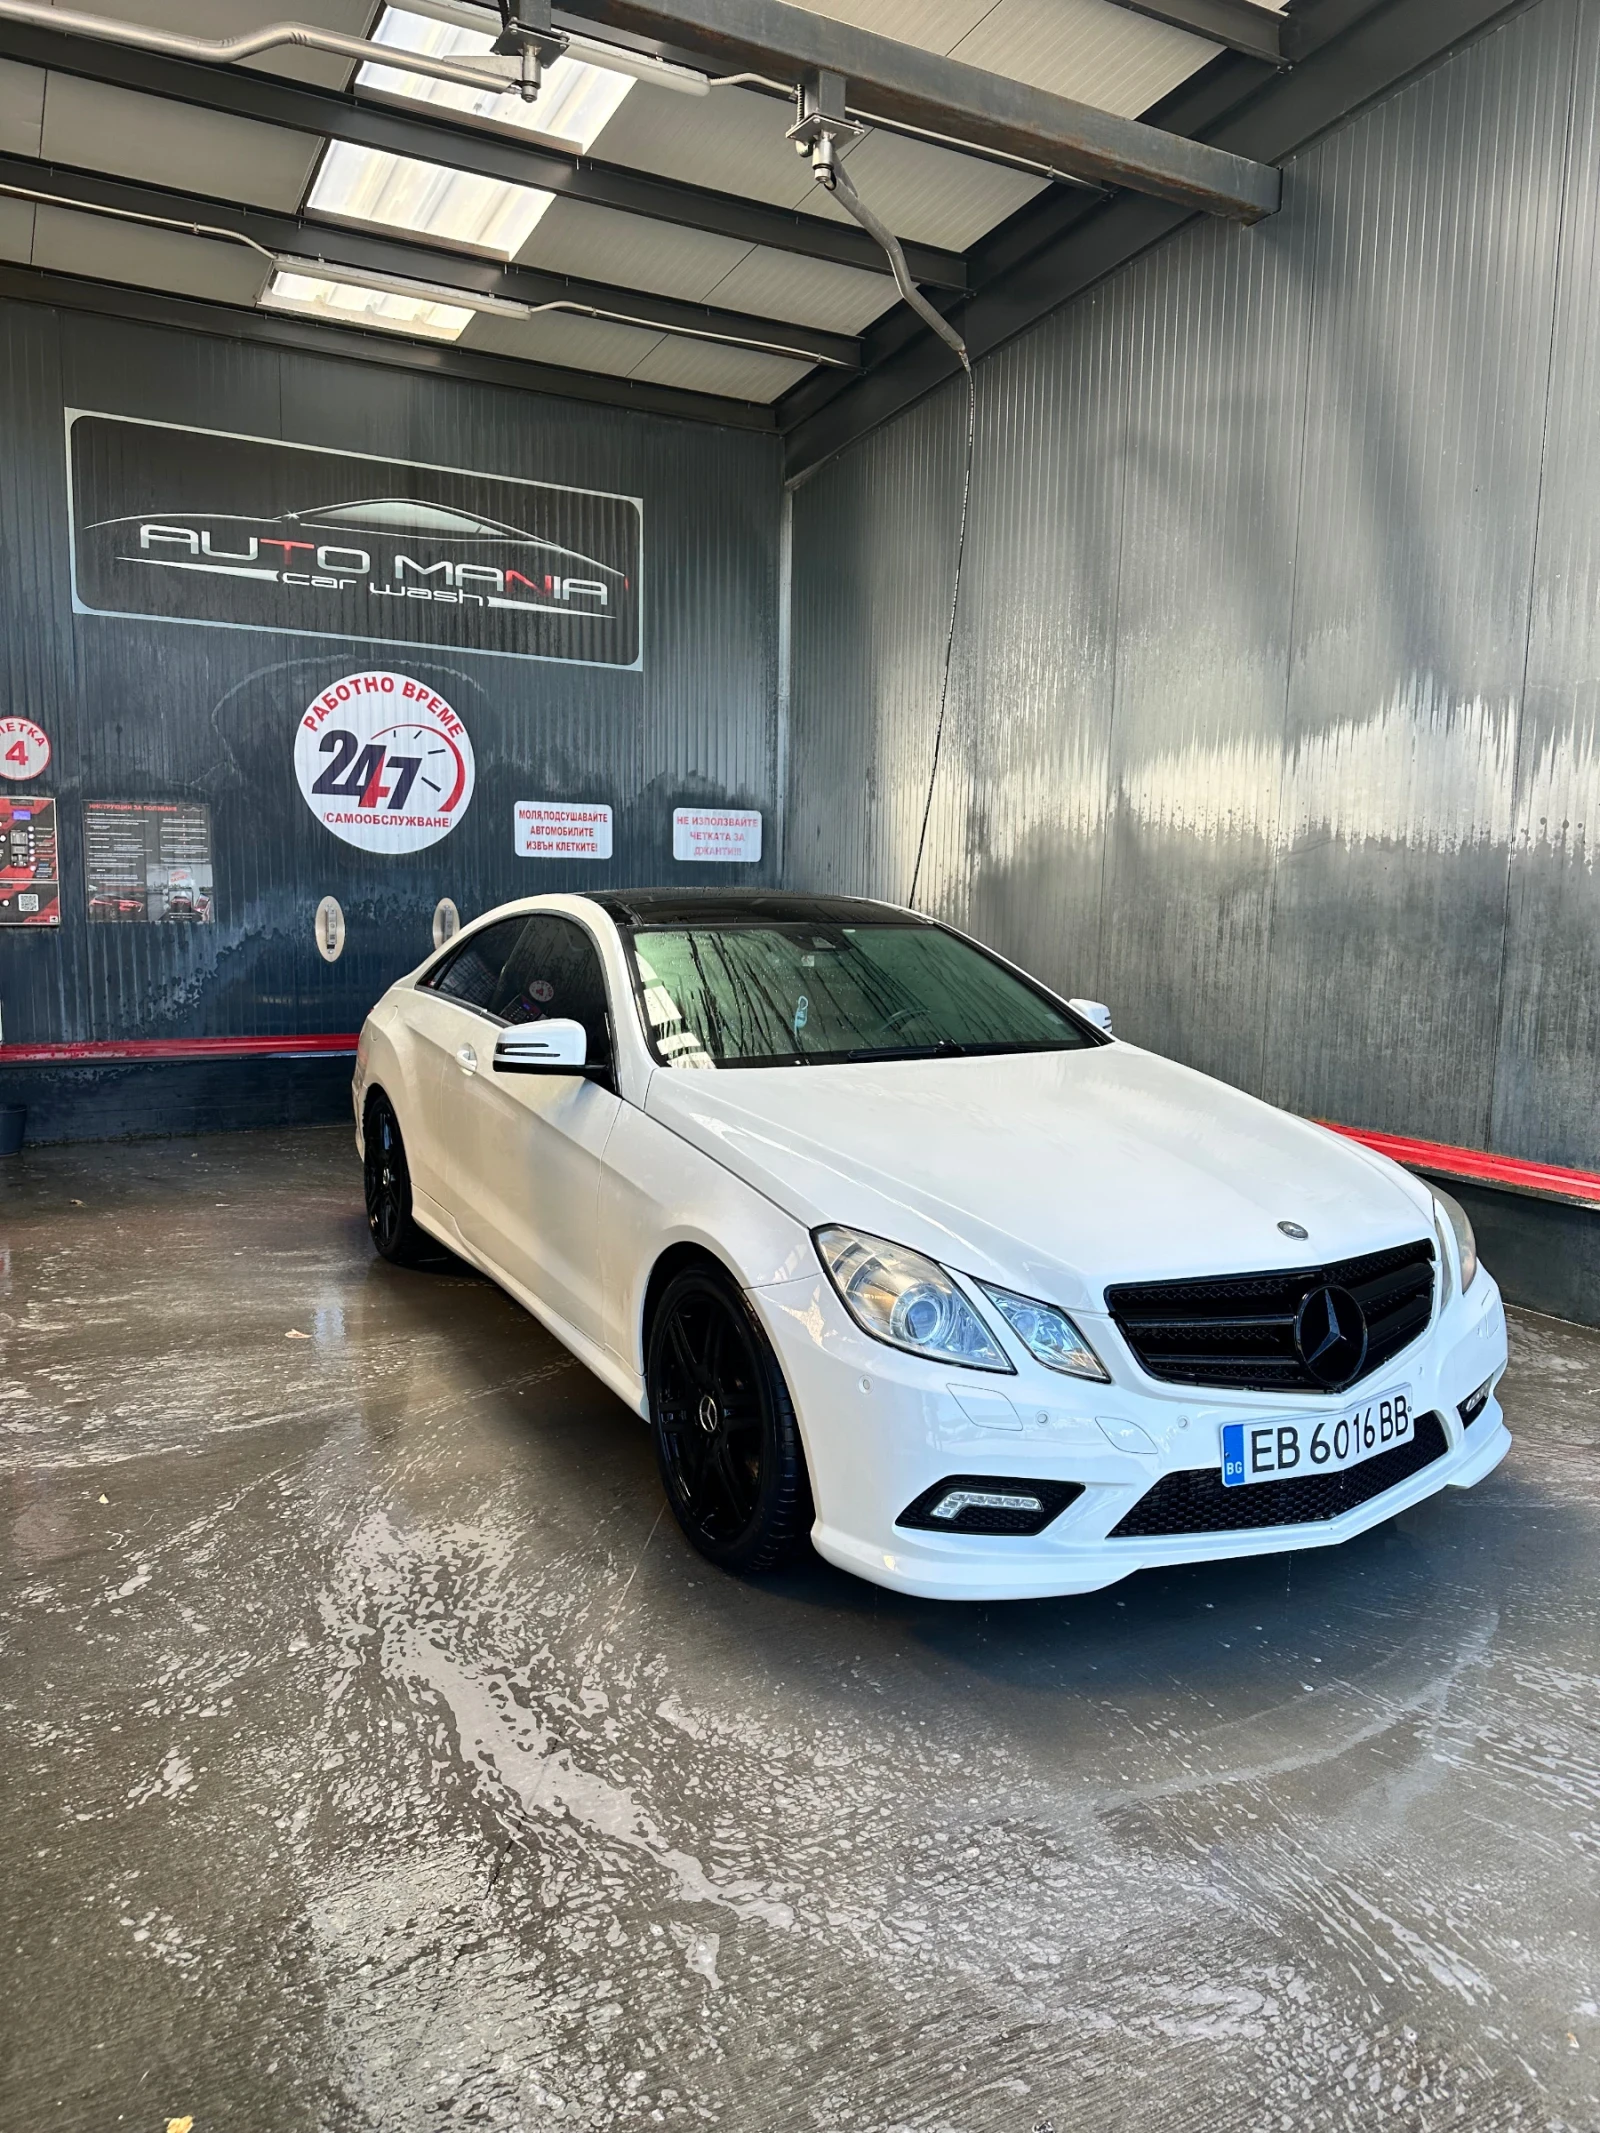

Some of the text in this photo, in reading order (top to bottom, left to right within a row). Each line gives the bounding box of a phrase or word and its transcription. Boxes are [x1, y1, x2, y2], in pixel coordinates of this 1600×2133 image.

[139, 523, 609, 606] AUTO MANIA
[282, 571, 484, 607] car wash
[303, 676, 464, 738] РАБОТНО ВРЕМЕ
[5, 740, 29, 766] 4
[530, 825, 594, 837] АВТОМОБИЛИТЕ
[676, 816, 759, 828] НЕ ИЗПОЛЗВАЙТЕ
[526, 840, 598, 853] ИЗВЪН КЛЕТКИТЕ!
[690, 831, 746, 842] ЧЕТКАТА ЗА
[1252, 1395, 1409, 1474] EB 6016 BB
[1226, 1461, 1243, 1476] BG
